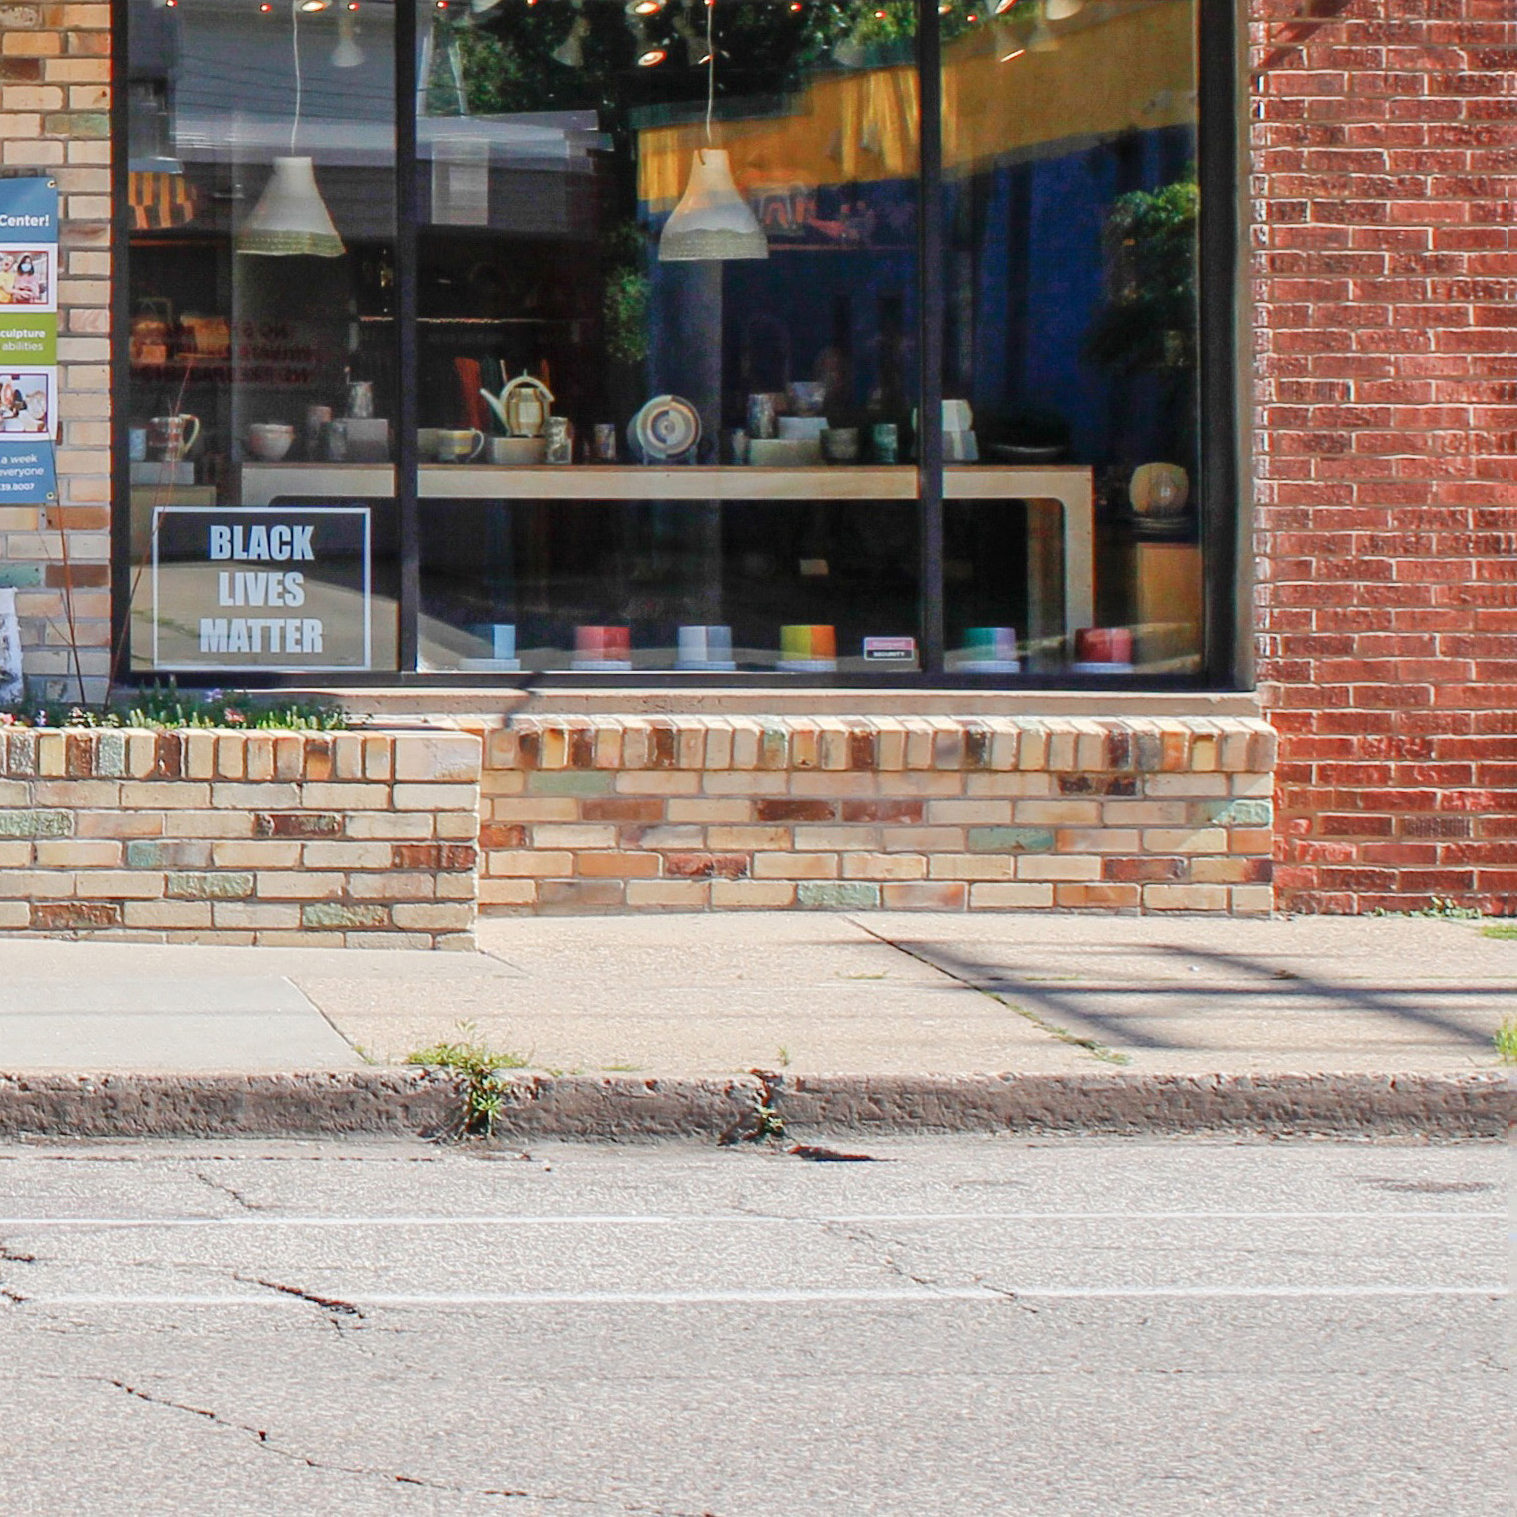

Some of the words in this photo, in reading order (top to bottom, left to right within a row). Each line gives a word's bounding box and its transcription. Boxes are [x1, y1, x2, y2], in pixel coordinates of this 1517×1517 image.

[1, 341, 44, 352] abilities
[0, 456, 8, 464] a
[10, 453, 38, 464] week
[210, 524, 315, 560] BLACK
[219, 571, 306, 607] LIVES
[200, 618, 323, 653] MATTER
